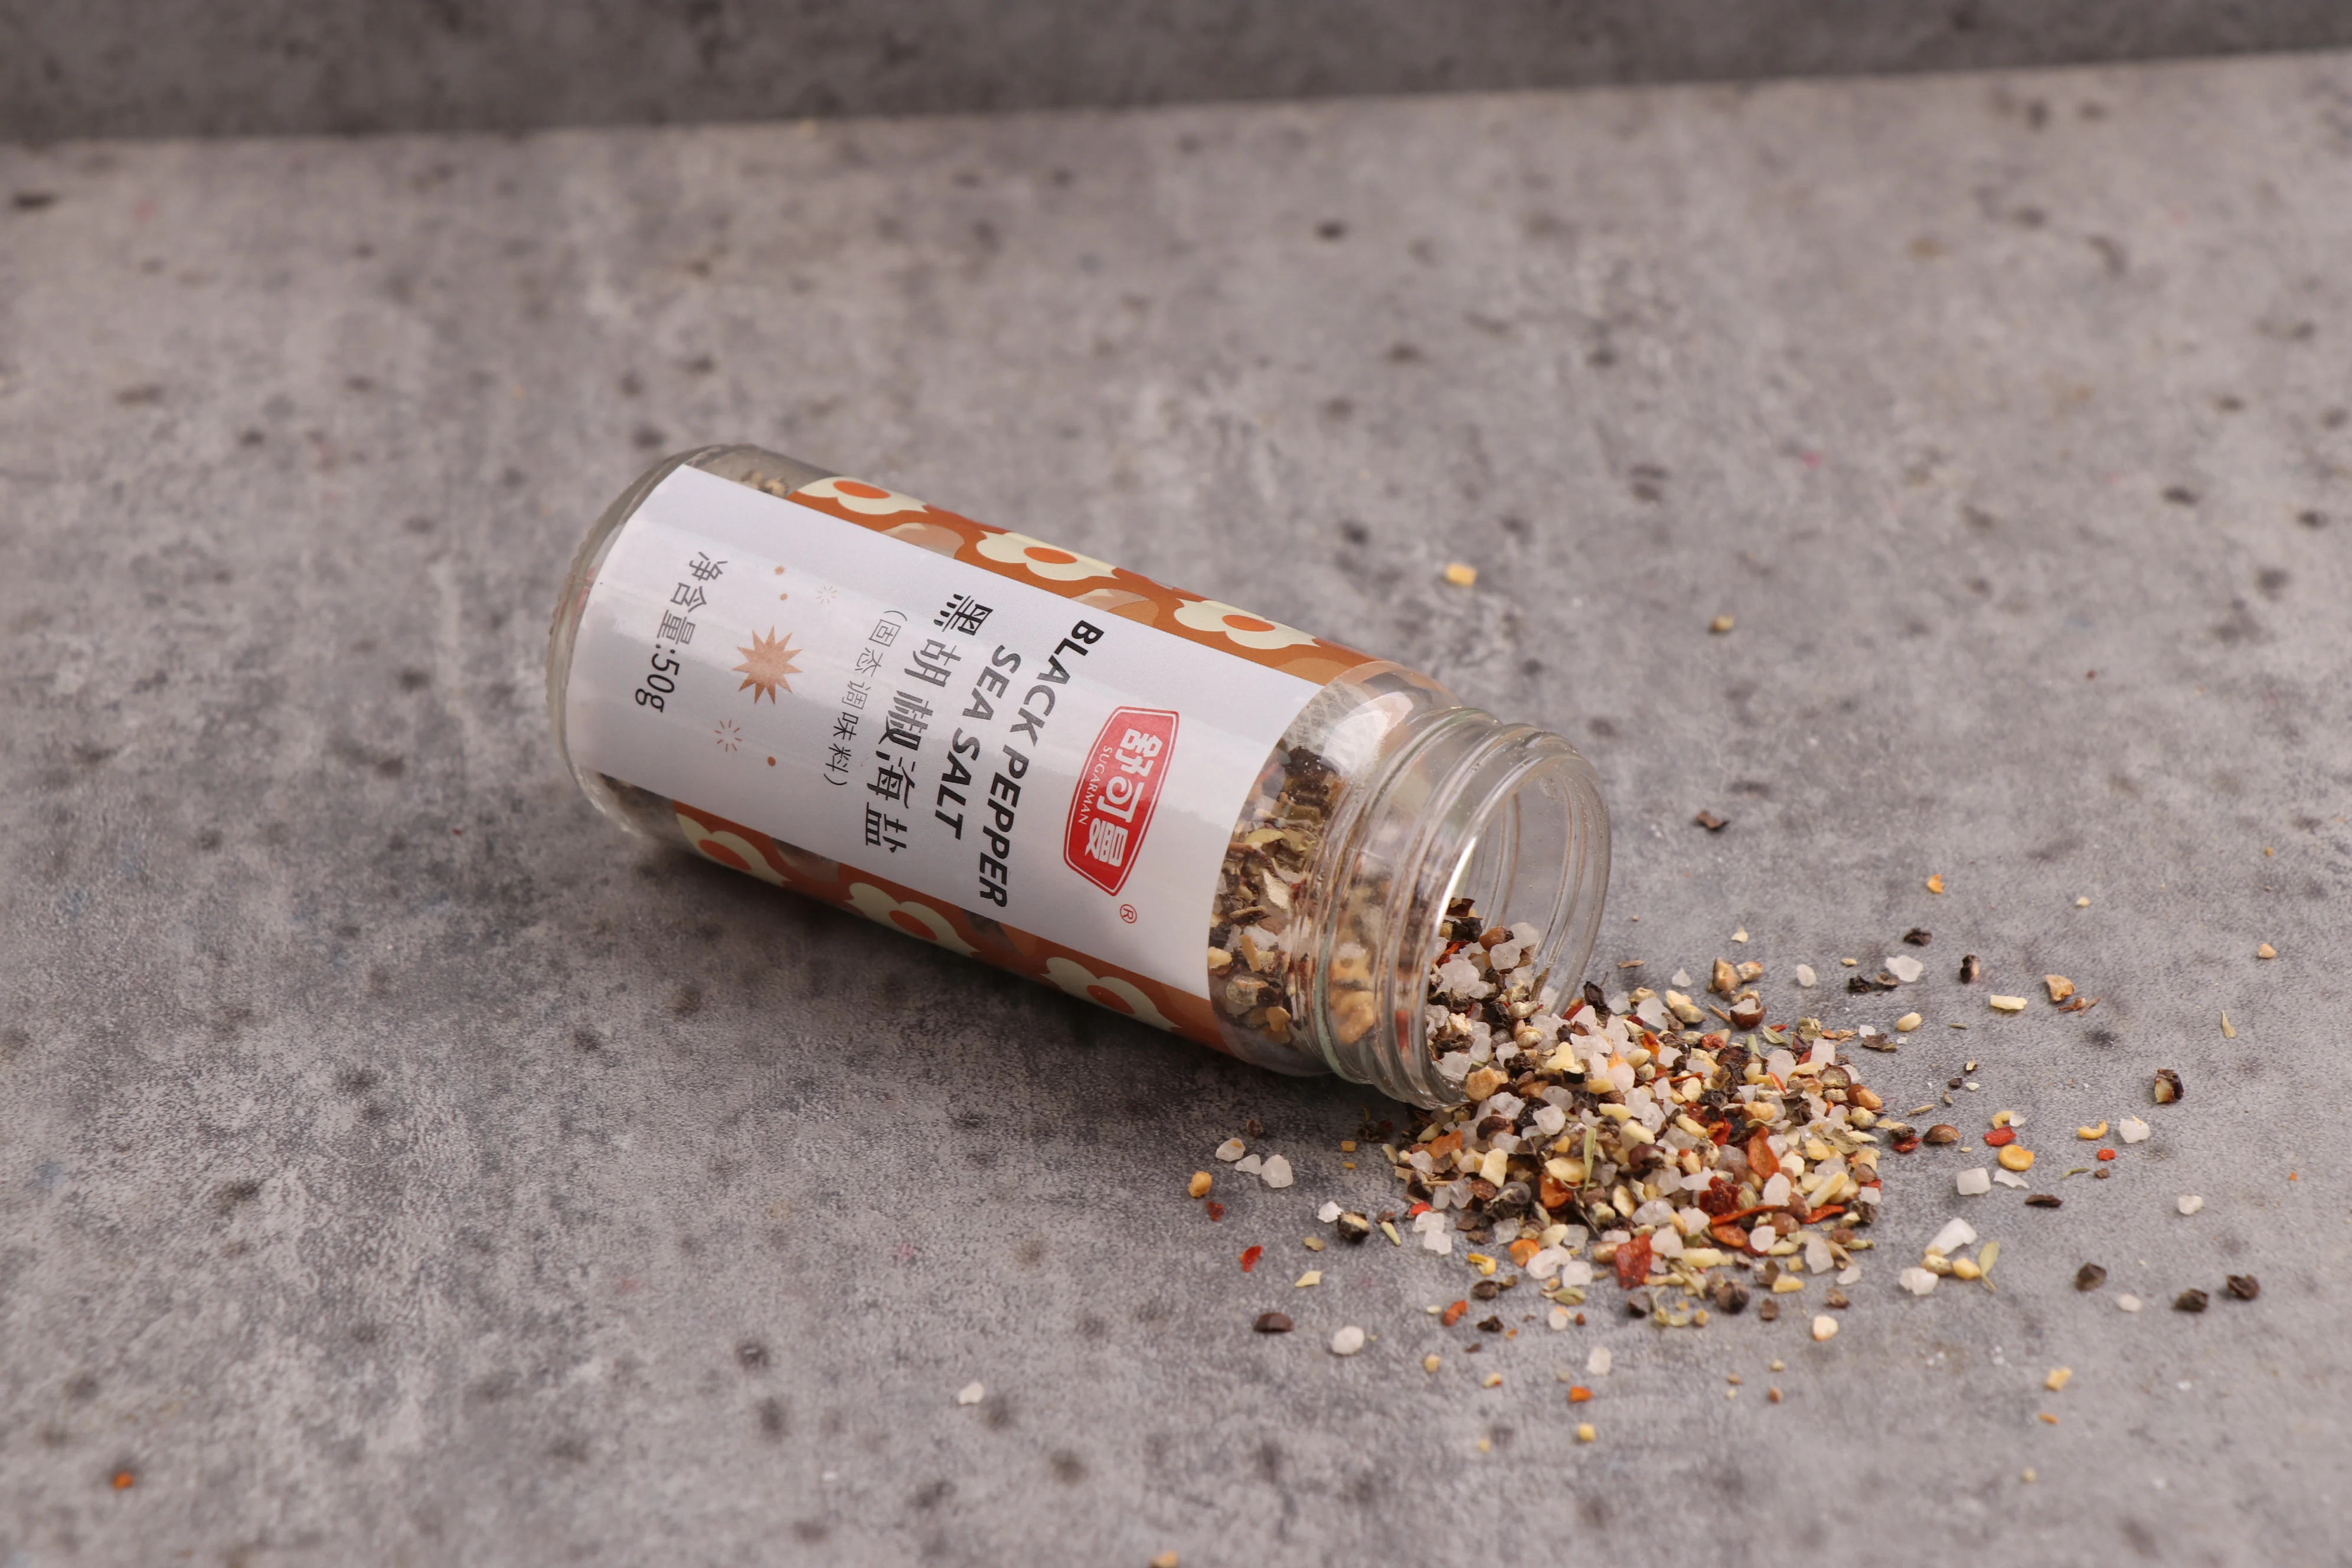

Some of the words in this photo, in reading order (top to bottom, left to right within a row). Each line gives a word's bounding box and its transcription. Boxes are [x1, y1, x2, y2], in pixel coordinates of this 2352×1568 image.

[635, 551, 728, 713] 净含量:50g
[962, 645, 1021, 720] SEA
[1010, 619, 1105, 747] BLACK
[865, 593, 993, 853] 黑胡椒海盐
[935, 727, 980, 840] SALT
[1078, 745, 1112, 825] SUGARMAN
[979, 744, 1030, 907] PEPPER
[1084, 728, 1163, 867] 舒可曼
